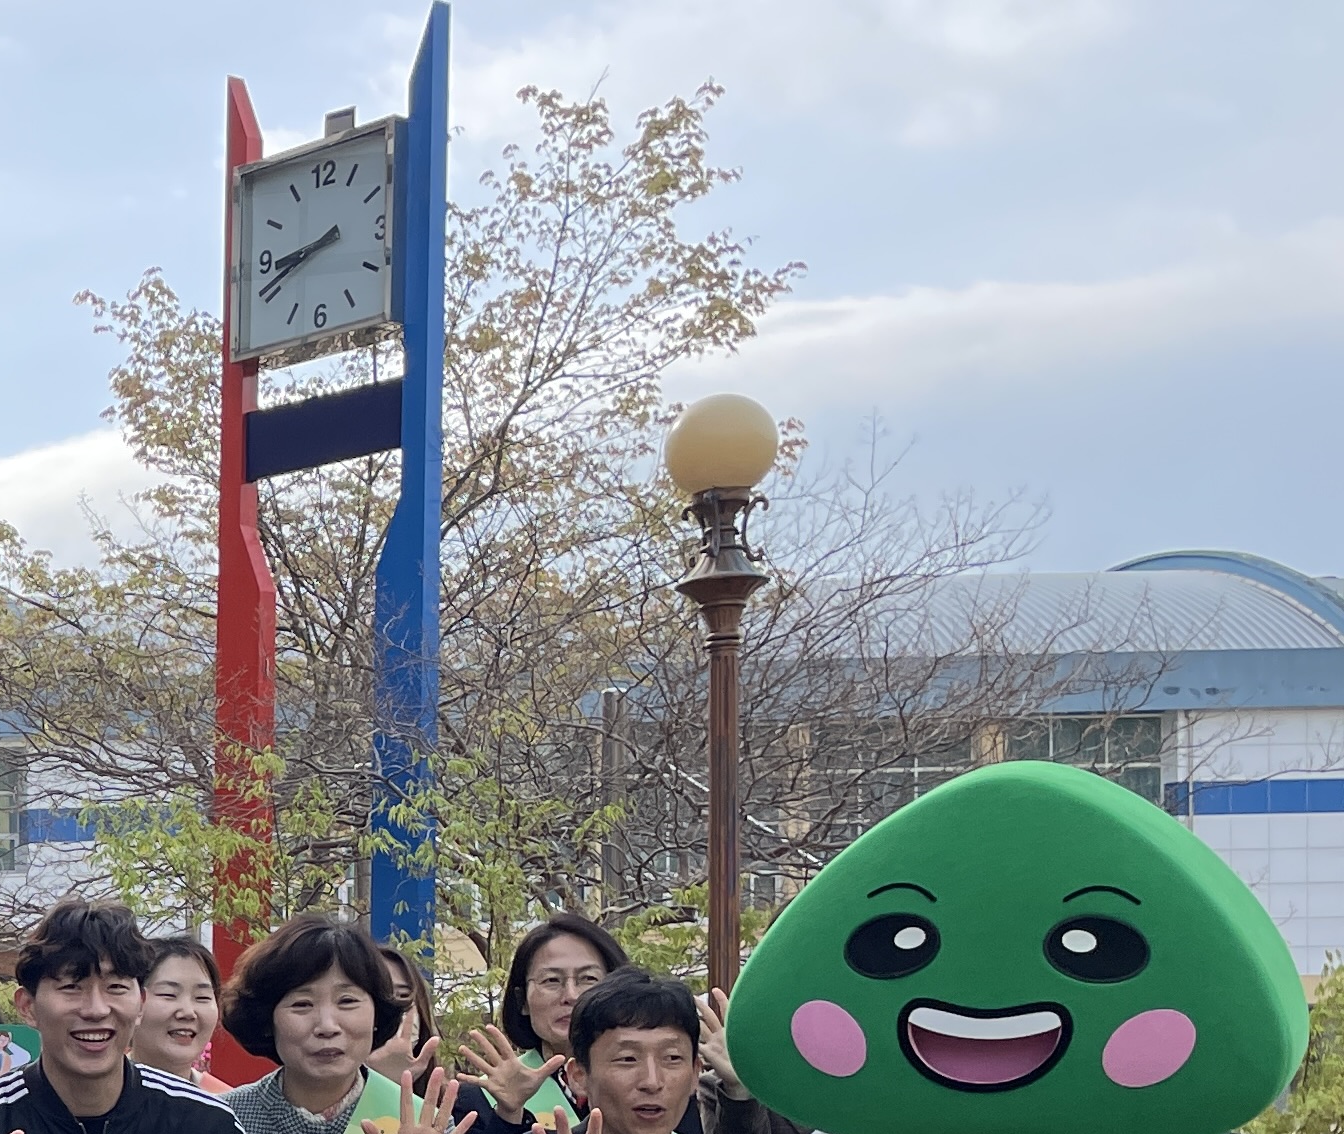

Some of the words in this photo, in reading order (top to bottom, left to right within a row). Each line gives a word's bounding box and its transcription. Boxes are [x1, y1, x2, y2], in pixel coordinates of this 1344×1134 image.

[312, 160, 336, 189] 12
[374, 214, 385, 240] 3
[259, 249, 272, 274] 9
[313, 303, 327, 328] 6
